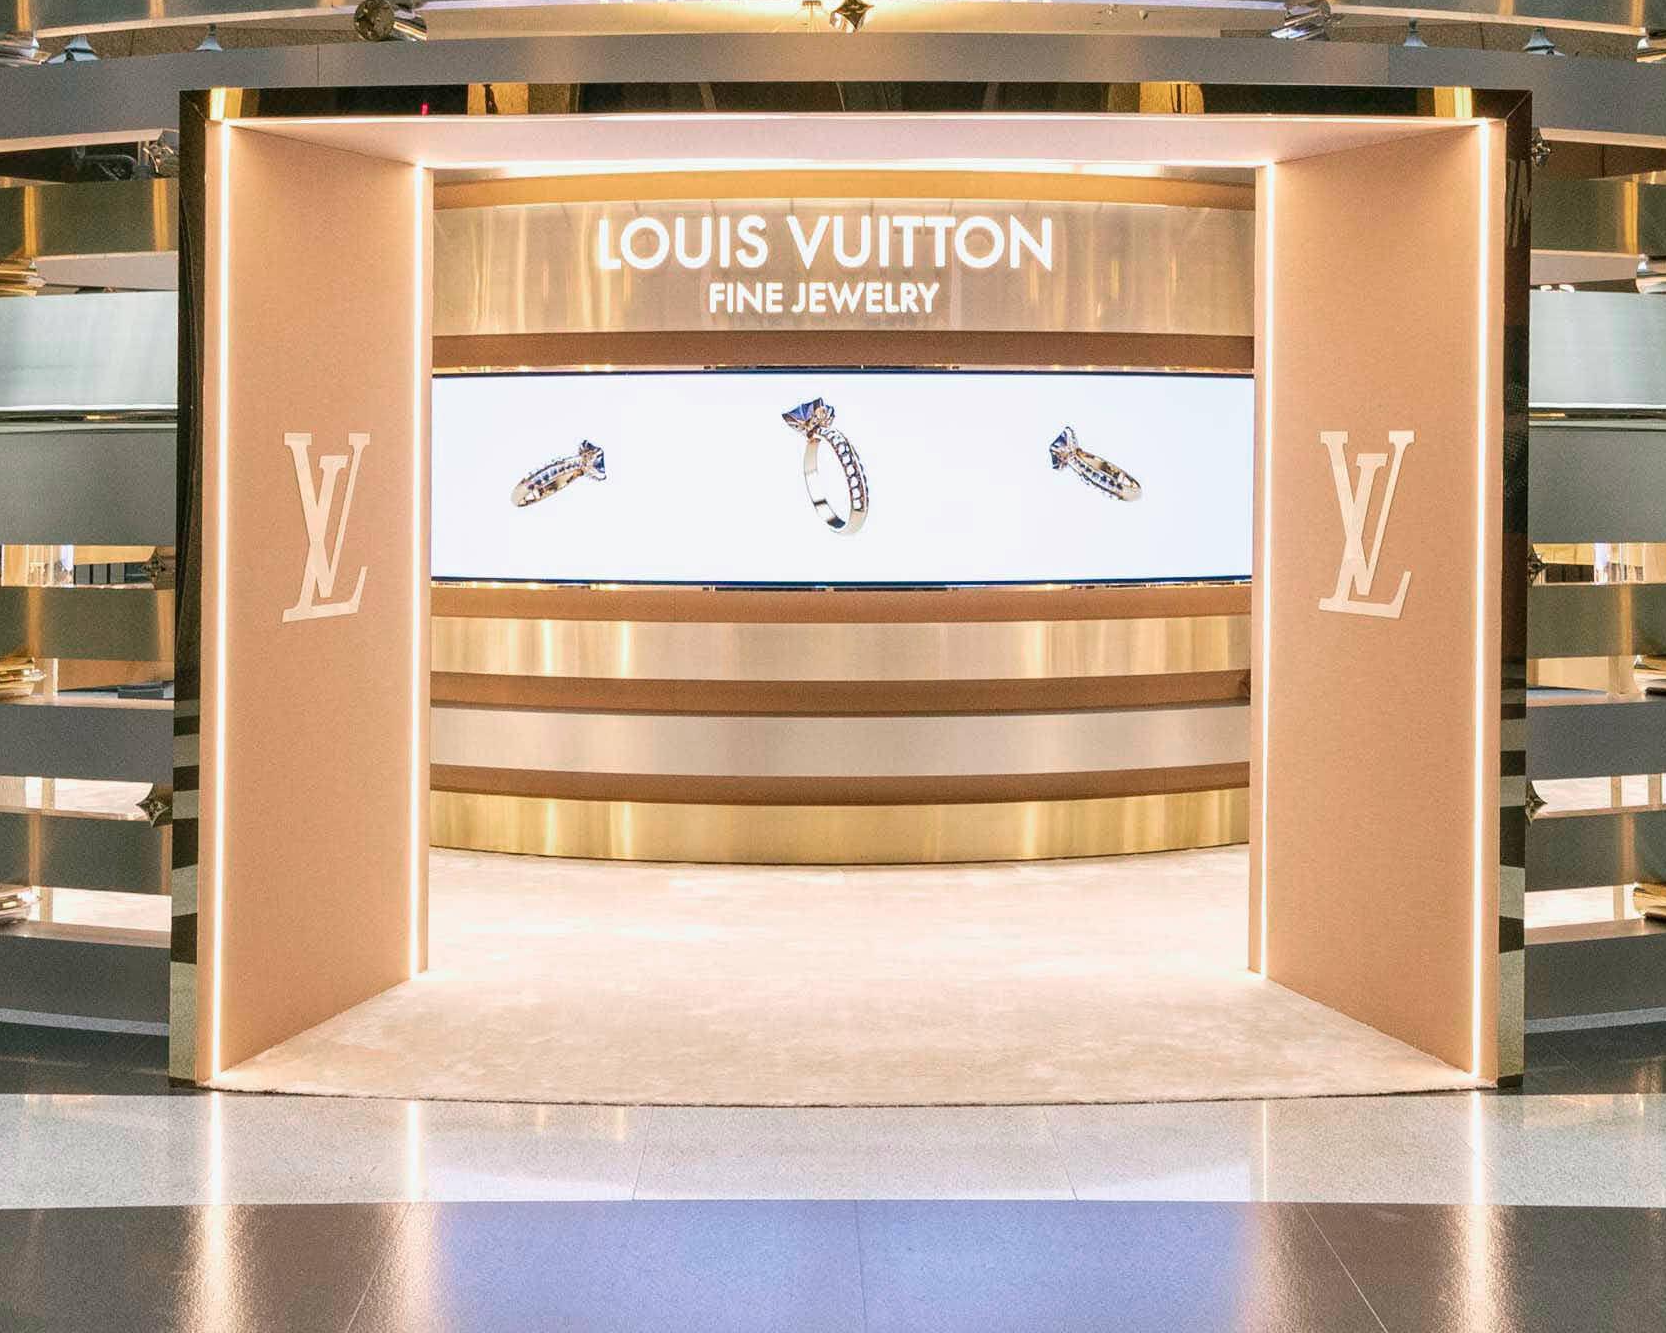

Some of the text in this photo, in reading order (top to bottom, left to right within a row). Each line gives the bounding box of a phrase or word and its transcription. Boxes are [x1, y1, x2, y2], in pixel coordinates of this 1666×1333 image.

[598, 214, 1052, 271] LOUIS VUITTON
[709, 281, 940, 314] FINE JEWELRY
[282, 432, 371, 623] LV
[1318, 430, 1415, 619] LV
